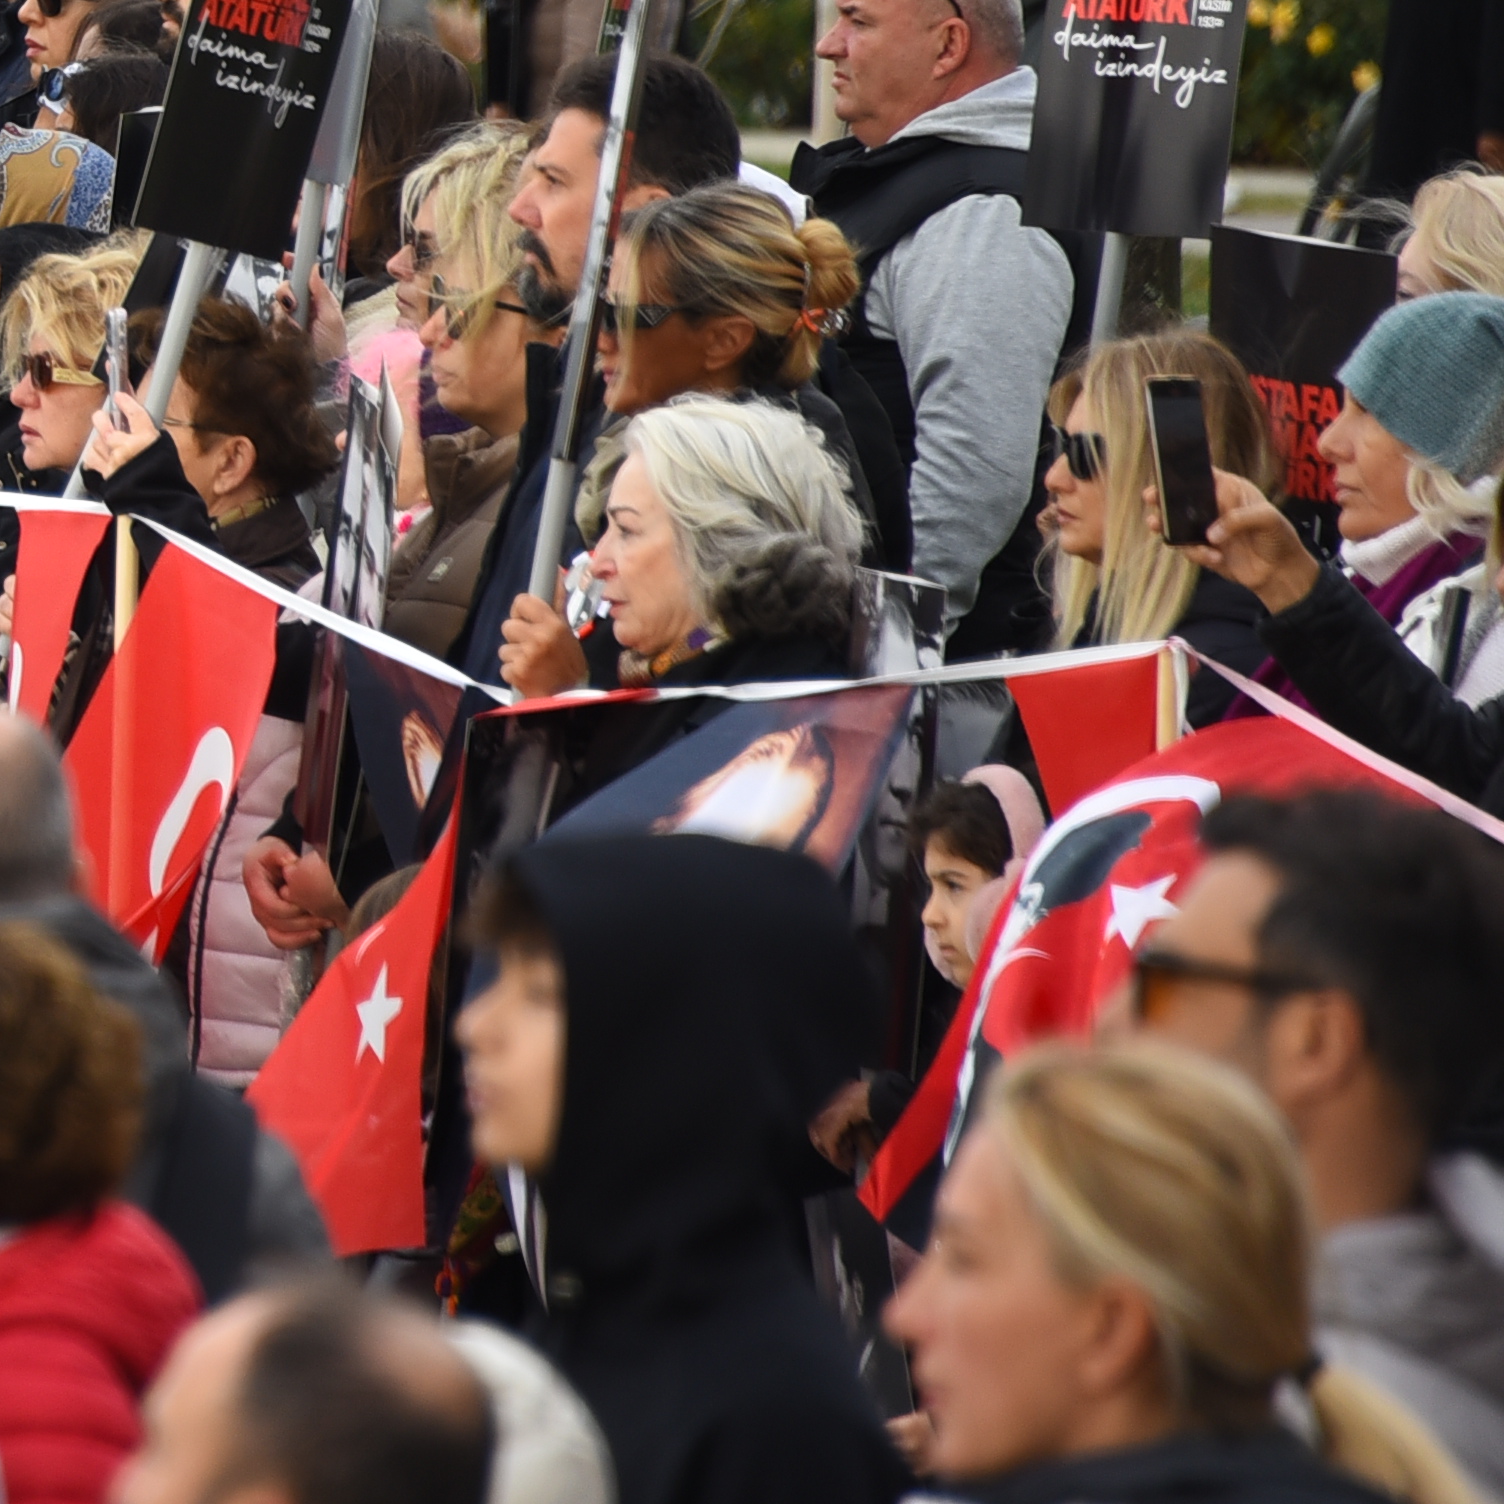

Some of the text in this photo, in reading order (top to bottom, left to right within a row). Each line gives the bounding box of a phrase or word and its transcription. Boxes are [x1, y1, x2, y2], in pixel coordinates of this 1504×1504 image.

[188, 8, 278, 66] daima
[1054, 3, 1156, 62] daima
[1094, 35, 1228, 109] izindeyiz
[1249, 374, 1341, 425] STAFA
